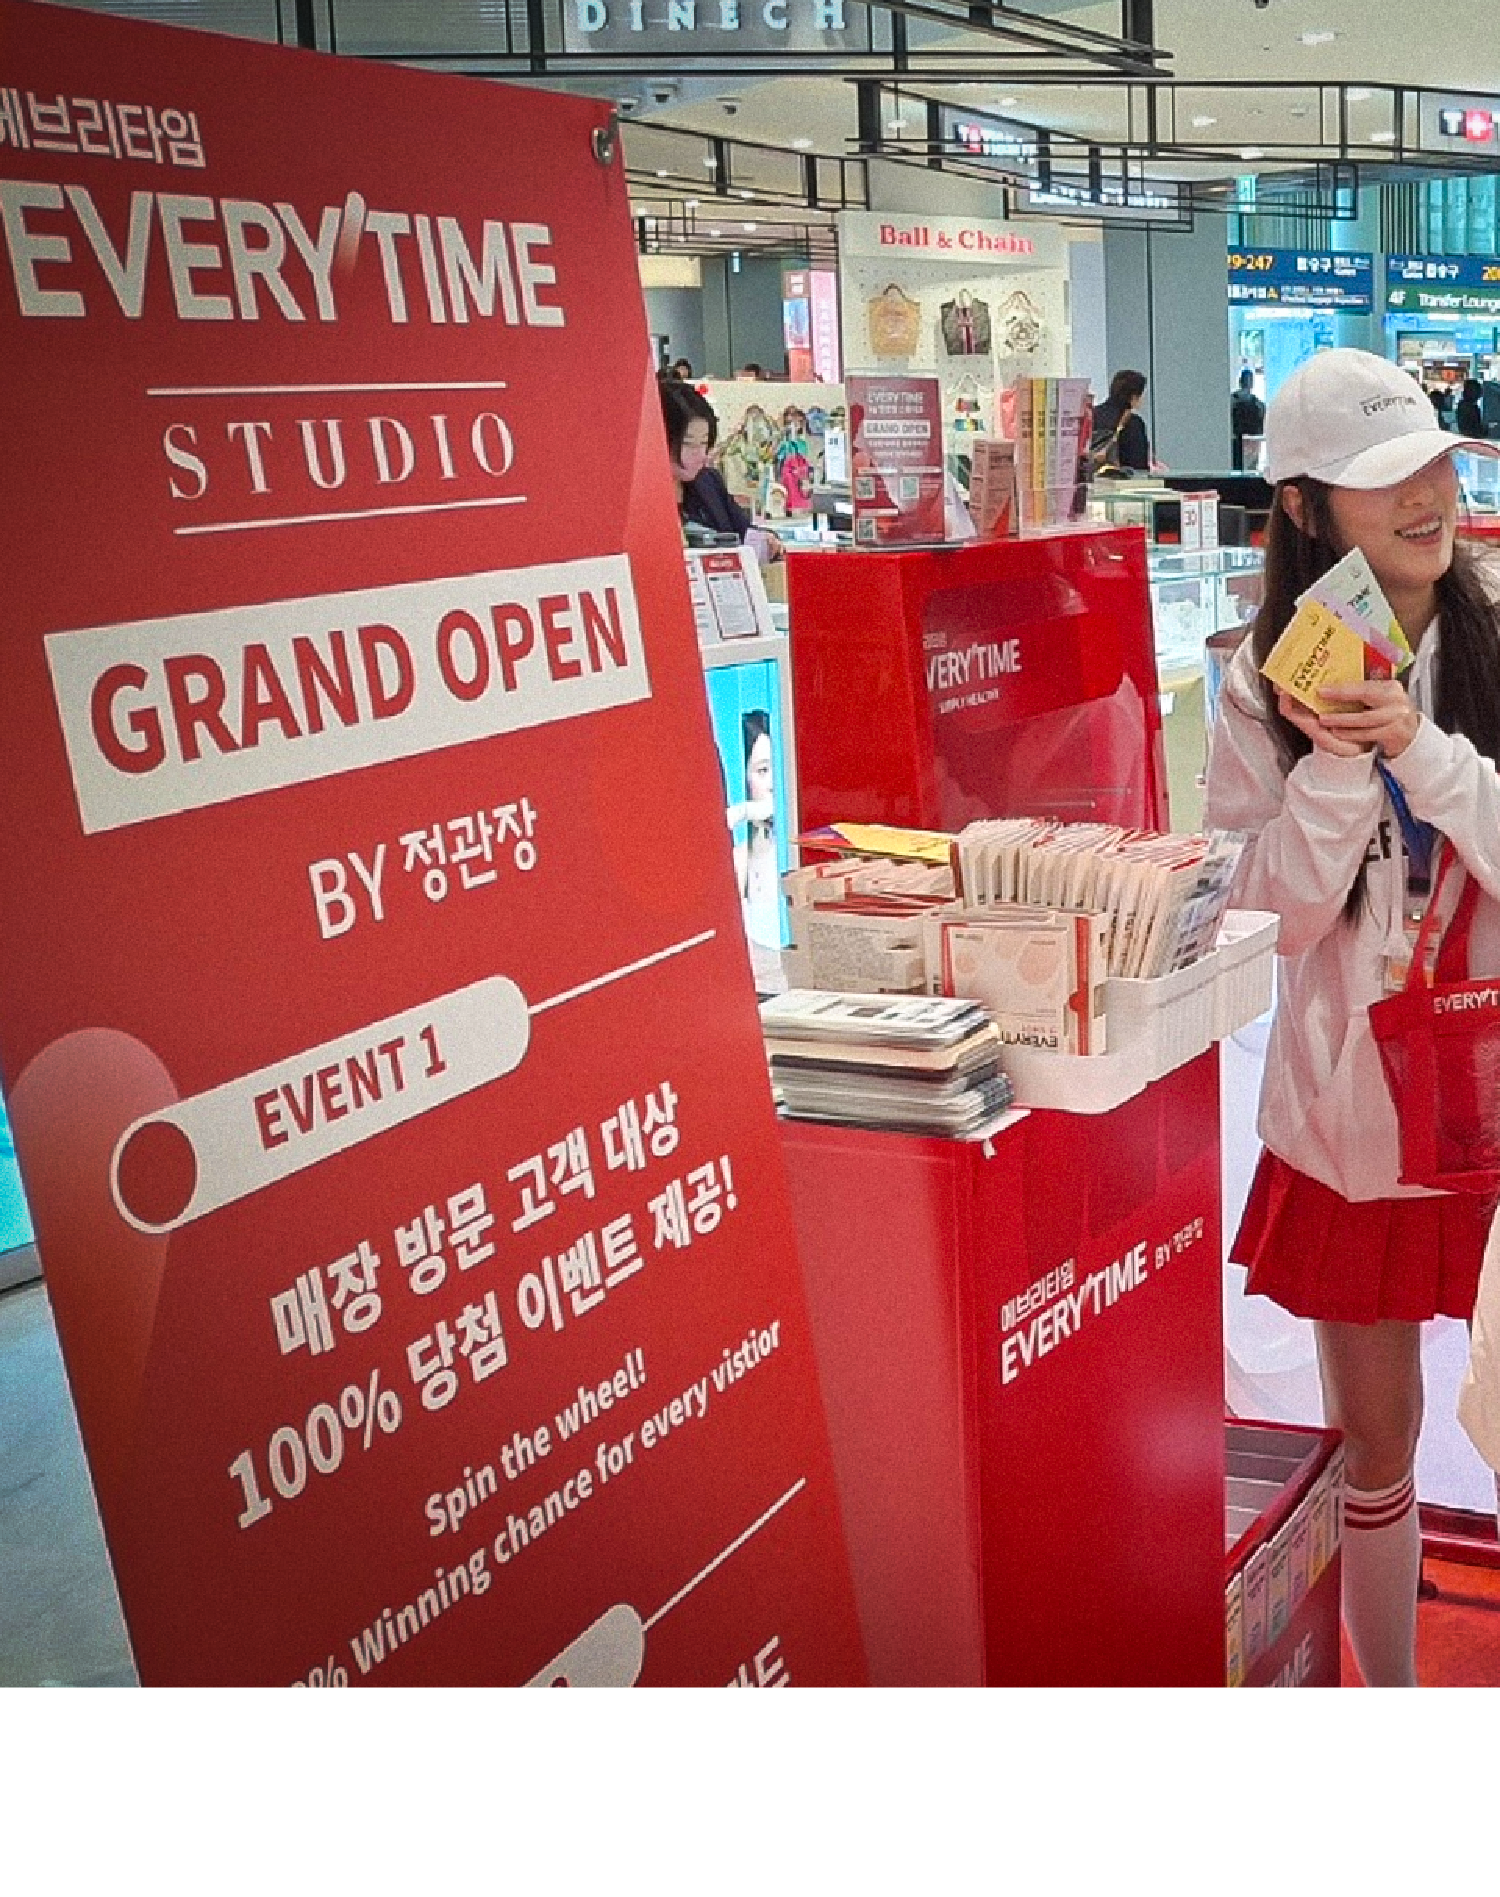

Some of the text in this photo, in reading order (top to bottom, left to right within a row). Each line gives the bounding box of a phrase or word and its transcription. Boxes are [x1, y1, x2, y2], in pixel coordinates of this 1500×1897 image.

[880, 225, 1034, 254] Ball & Chain
[163, 411, 516, 499] STUDIO
[90, 623, 417, 775] GRAND
[435, 587, 629, 703] OPEN
[309, 797, 537, 940] BY 정관장
[254, 1024, 448, 1149] EVENT 1
[270, 1082, 681, 1358] 매장 방문 고객 대상
[1155, 1240, 1172, 1270] BY
[228, 1156, 739, 1531] 100% 당첨 이벤트 제공!
[1001, 1258, 1075, 1332] 에브리타임
[425, 1348, 646, 1540] Spin the wheel!
[350, 1548, 493, 1677] Winning
[494, 1469, 594, 1564] chance
[596, 1432, 635, 1487] for
[638, 1374, 711, 1448] every
